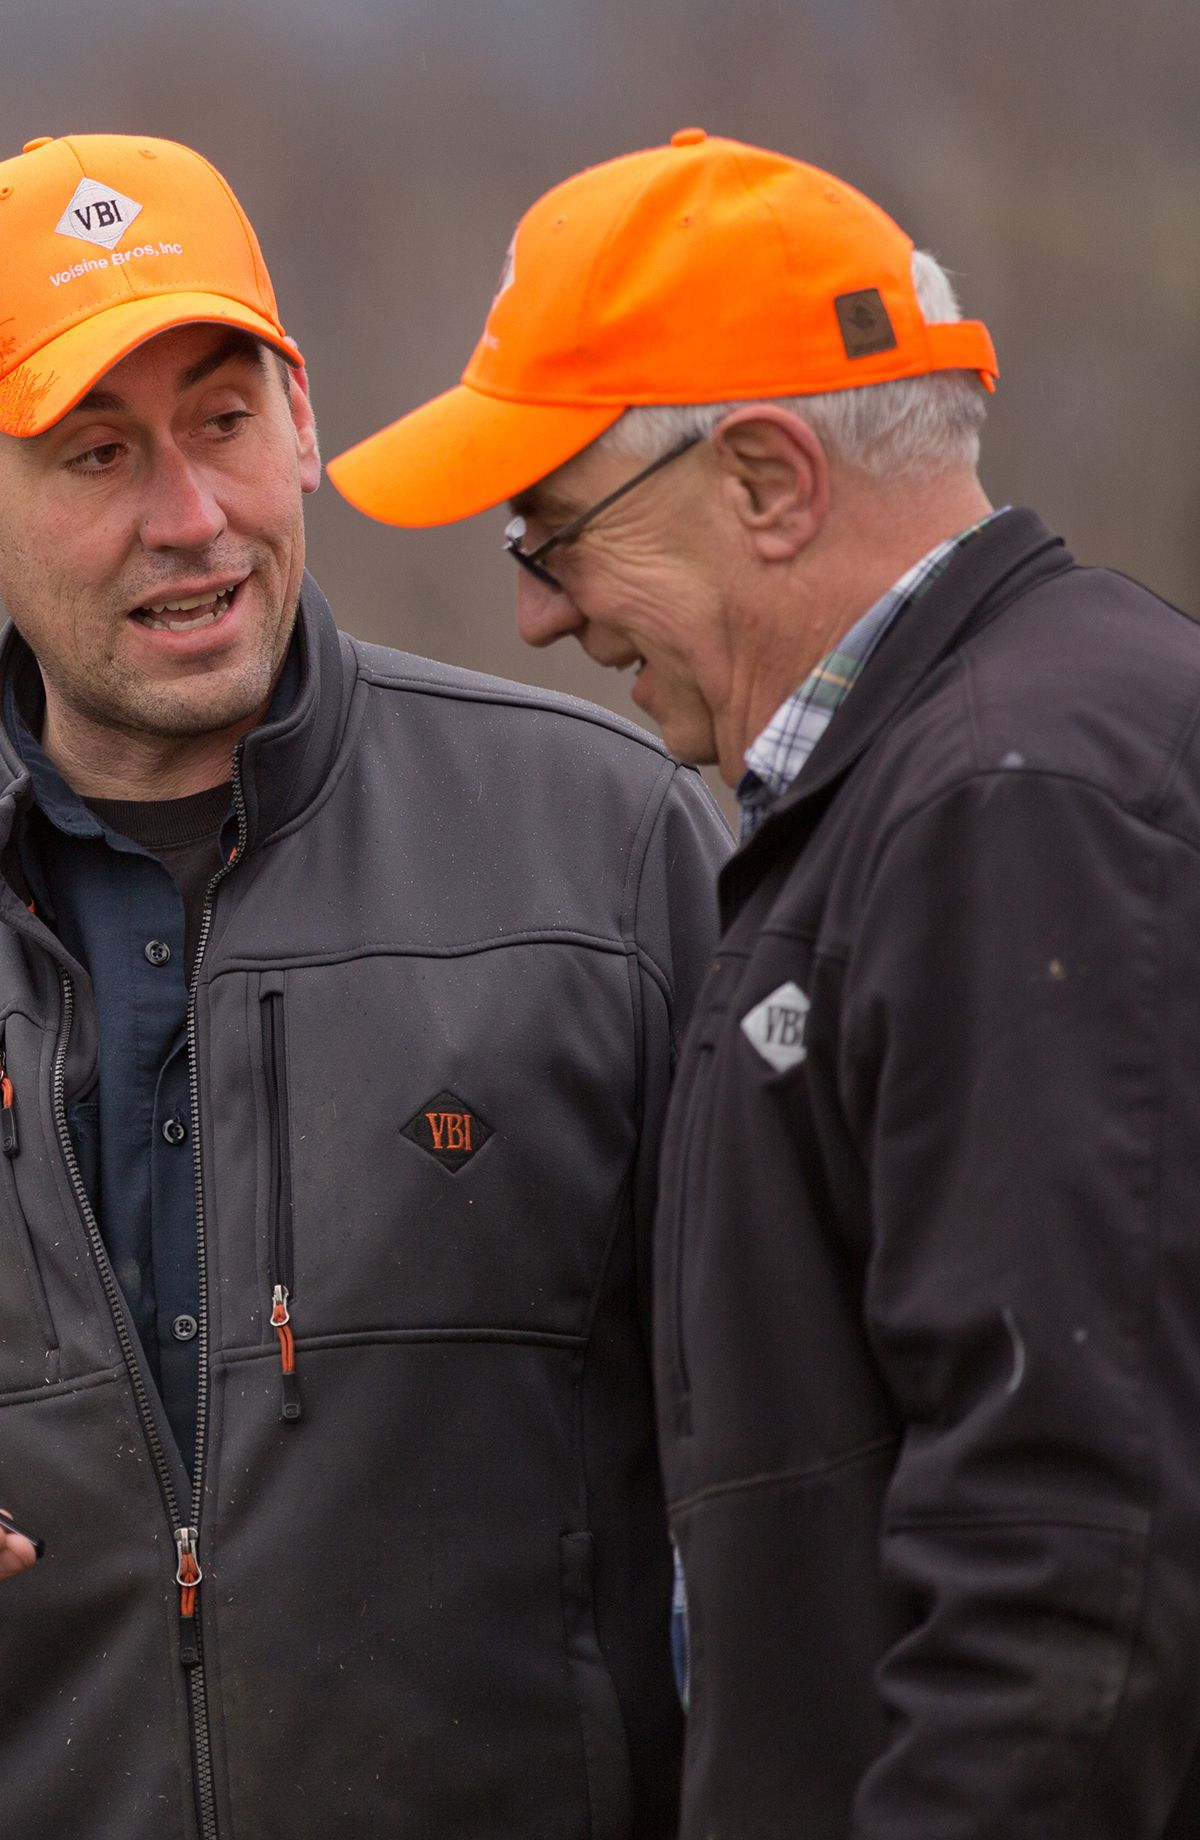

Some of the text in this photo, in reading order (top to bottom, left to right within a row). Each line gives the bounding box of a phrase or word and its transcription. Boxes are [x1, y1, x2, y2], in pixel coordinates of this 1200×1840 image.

[74, 200, 123, 231] VBI
[49, 257, 109, 287] Voisine
[425, 1113, 472, 1151] VBI
